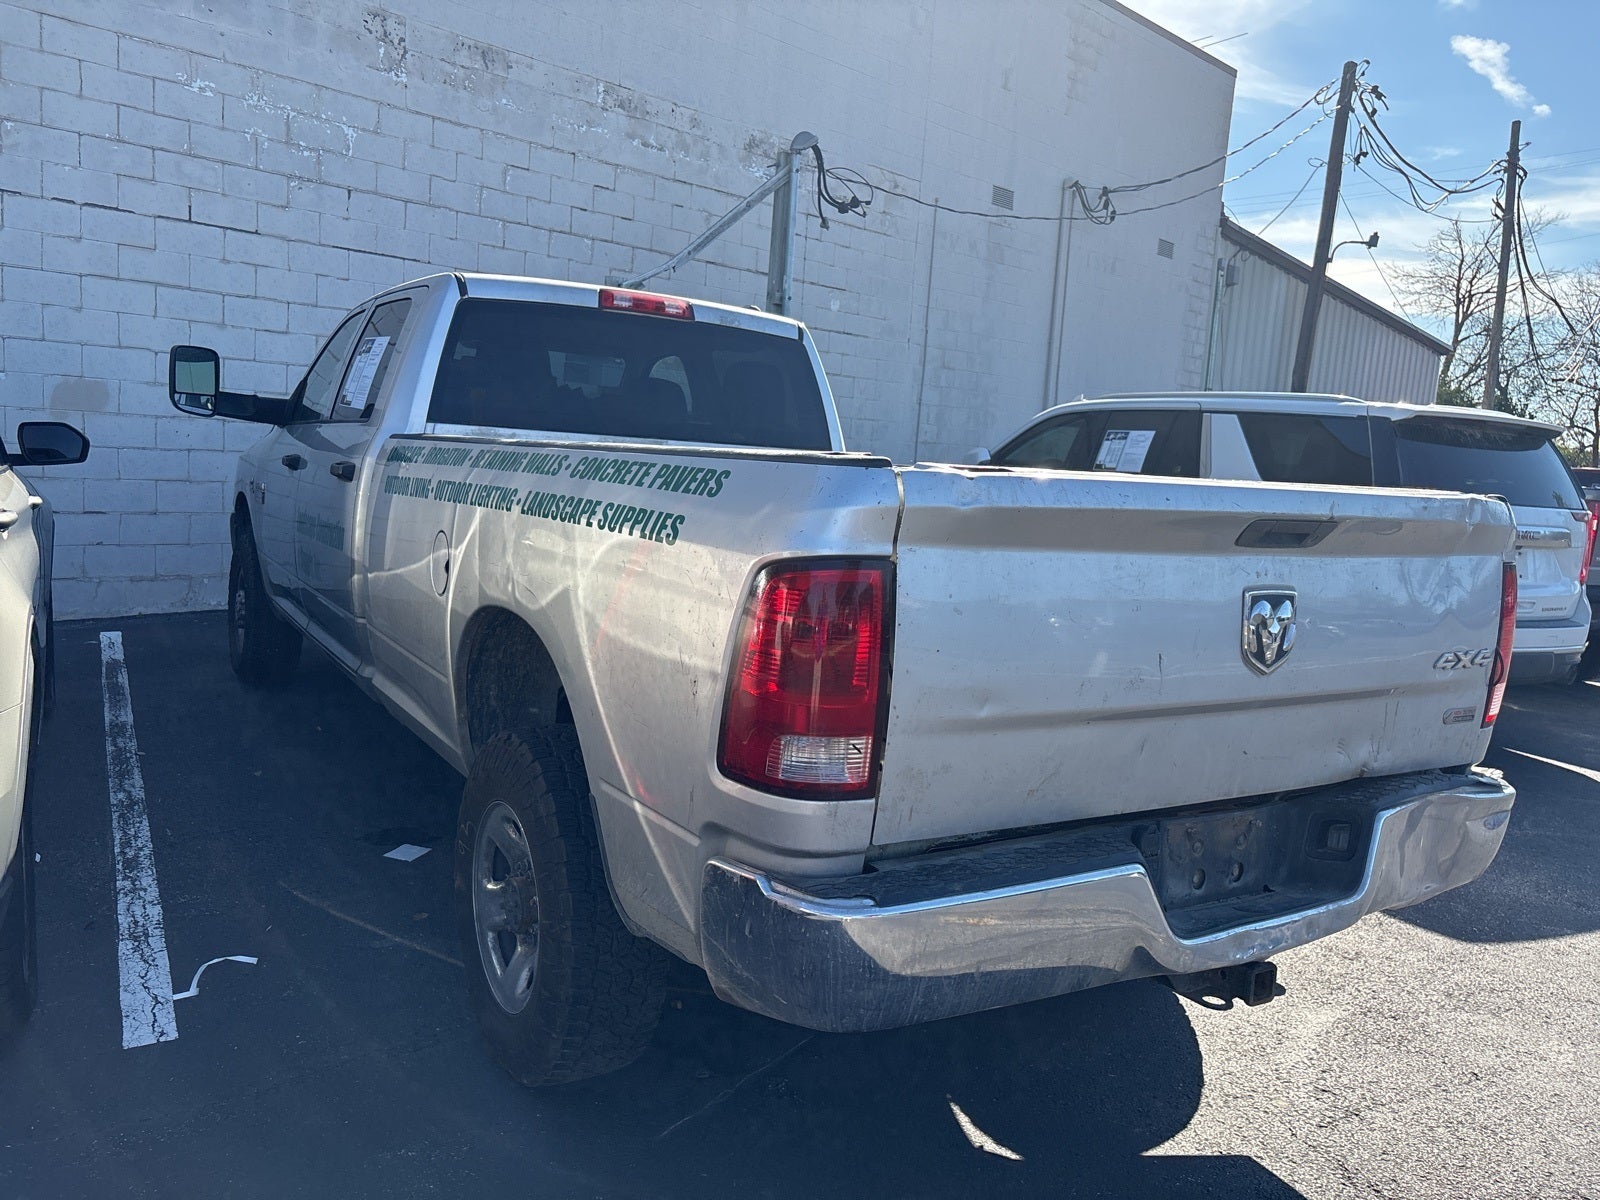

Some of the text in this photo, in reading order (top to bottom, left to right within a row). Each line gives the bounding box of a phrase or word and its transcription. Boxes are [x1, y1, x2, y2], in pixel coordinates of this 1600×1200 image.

[469, 450, 529, 472] RETAINING
[521, 452, 569, 476] WALLS
[569, 456, 657, 488] CONCRETE
[647, 463, 731, 498] PAVERS
[384, 475, 686, 546] OUTDOOR LIVING OUTDOOR LIGHTING LANDSCAPE SUPPLIES
